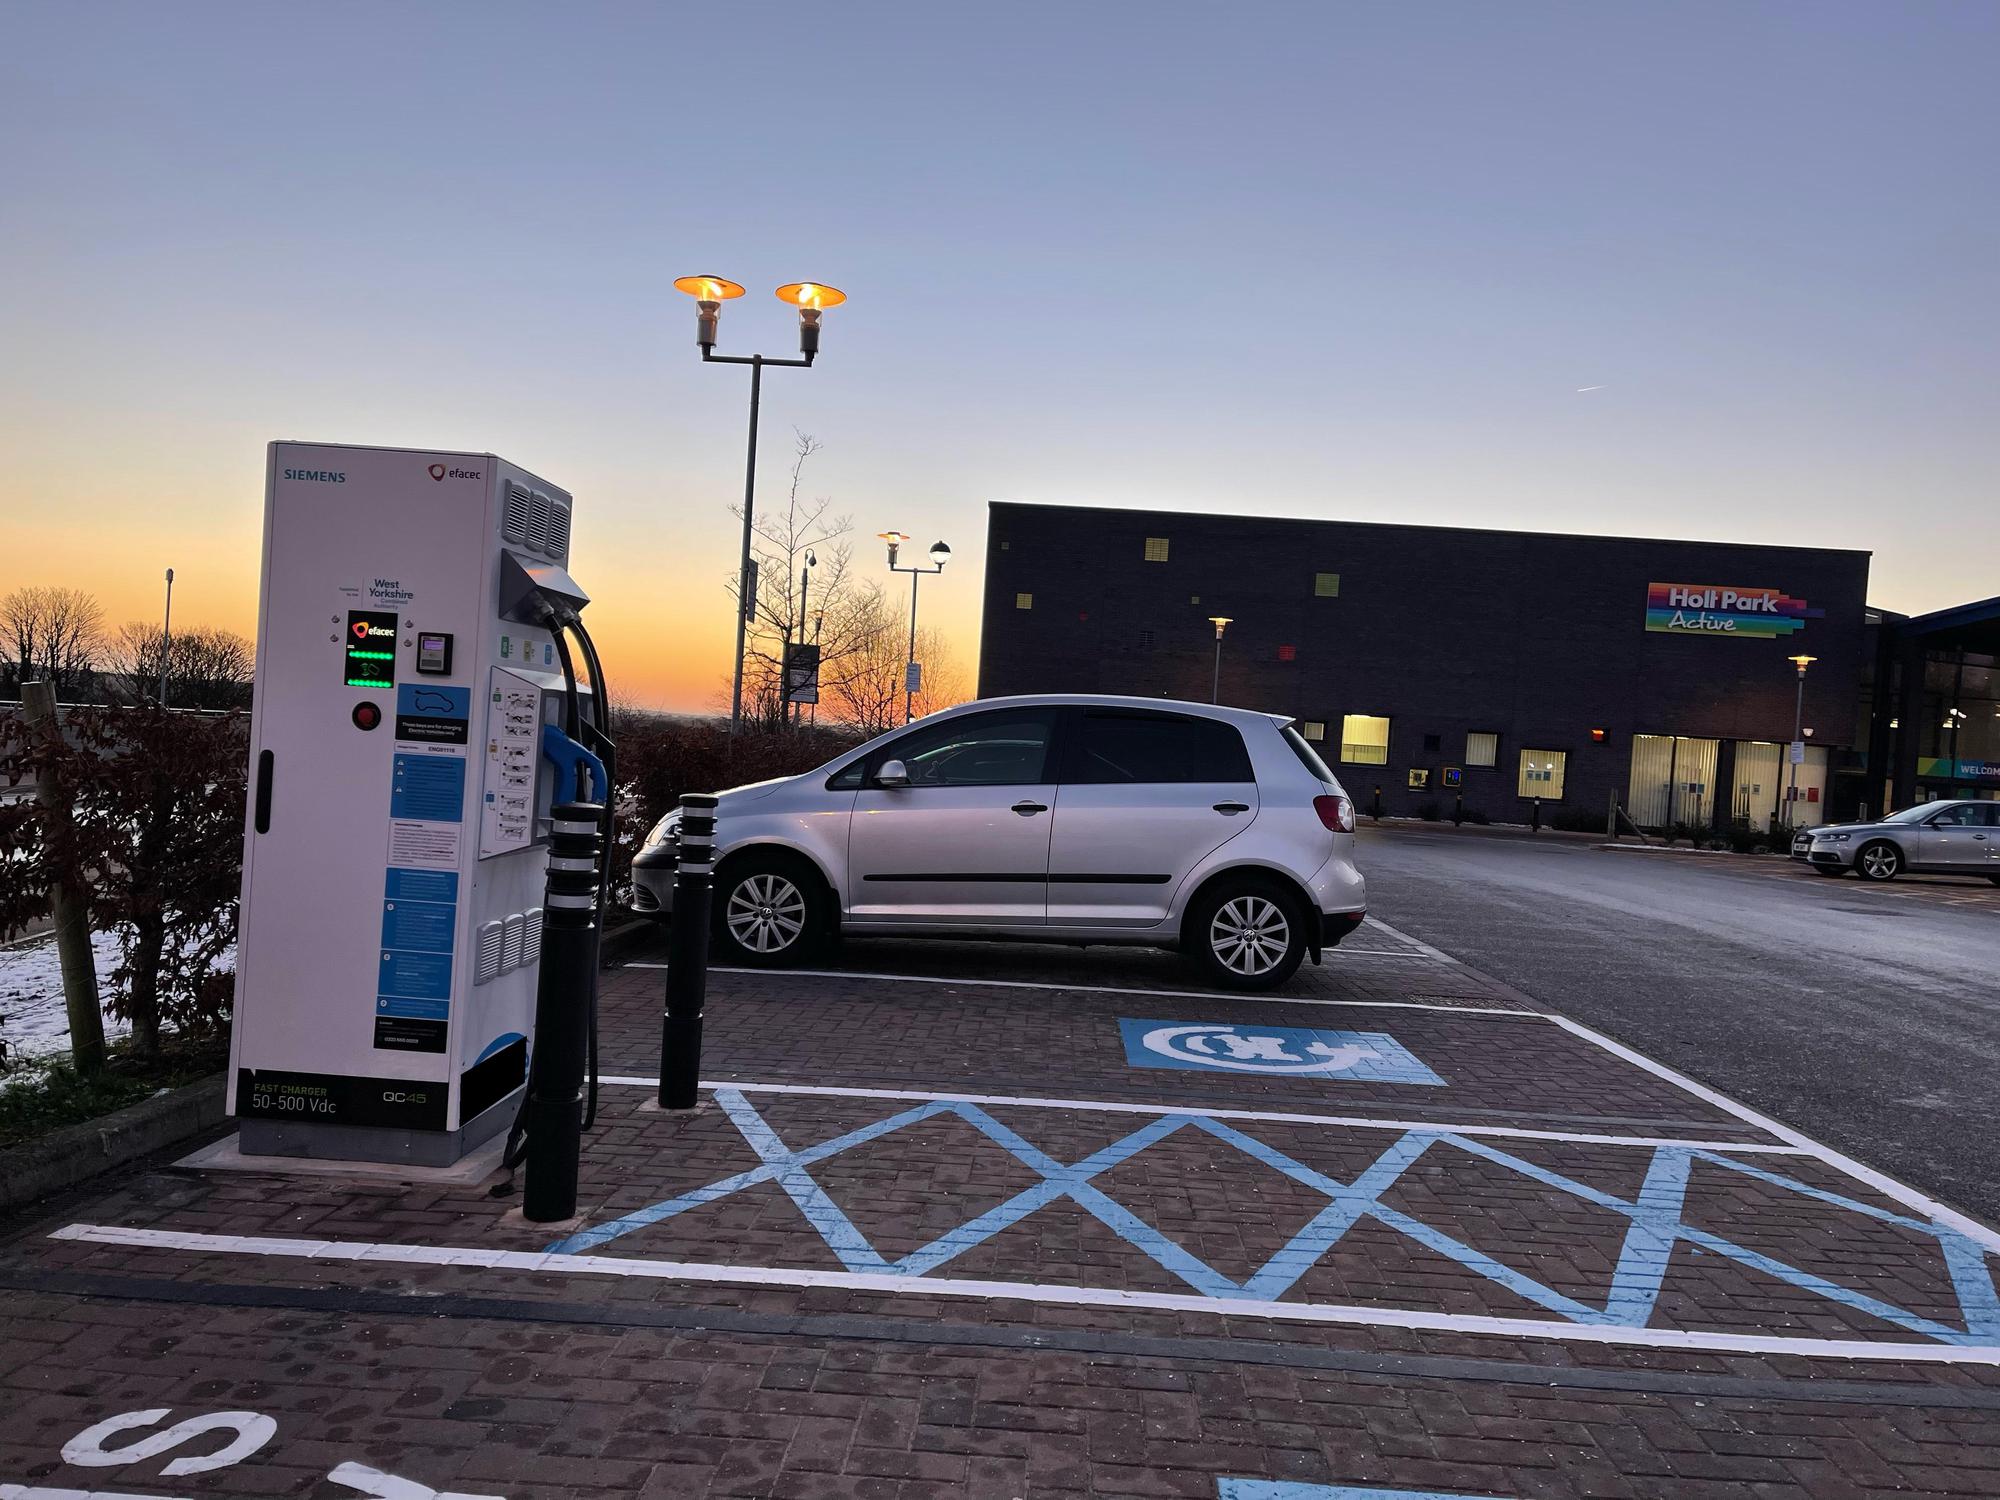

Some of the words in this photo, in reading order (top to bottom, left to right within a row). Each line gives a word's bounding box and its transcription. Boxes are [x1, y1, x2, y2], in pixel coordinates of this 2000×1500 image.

[284, 469, 346, 483] SIEMENS
[449, 468, 481, 480] efacec
[374, 578, 400, 589] West
[369, 588, 414, 599] Yorkshire
[1668, 588, 1718, 609] Holt
[1721, 591, 1778, 612] Park
[1667, 610, 1737, 631] Active
[368, 626, 395, 637] efacec
[1961, 765, 2000, 776] WELCOM
[254, 1083, 278, 1093] FAST
[281, 1085, 327, 1097] CHARGER
[252, 1093, 305, 1112] 50-500
[309, 1098, 337, 1114] Vdc
